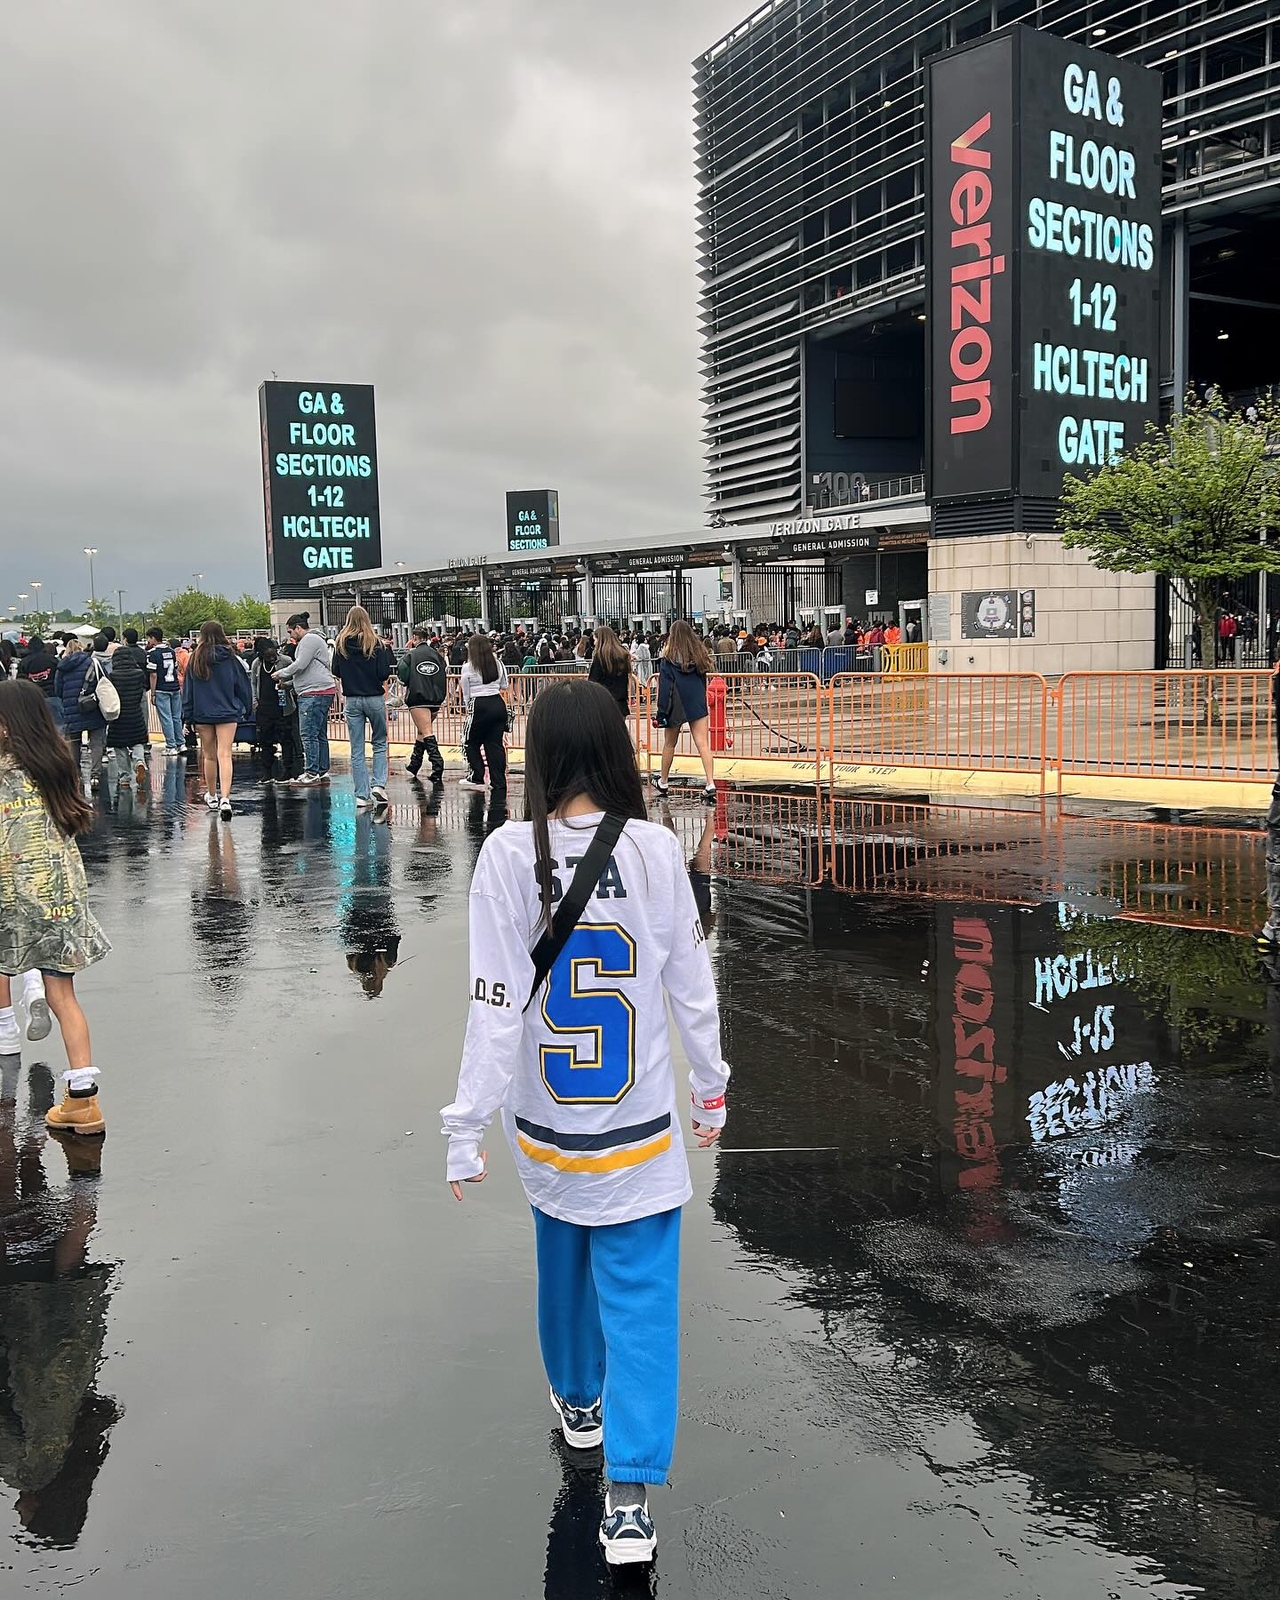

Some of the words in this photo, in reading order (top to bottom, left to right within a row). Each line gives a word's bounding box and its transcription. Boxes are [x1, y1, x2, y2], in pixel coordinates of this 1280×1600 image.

[1063, 63, 1102, 121] GA
[1106, 77, 1124, 127] &
[1049, 130, 1137, 199] FLOOR
[1028, 197, 1154, 271] SECTIONS
[950, 112, 1005, 435] verizon
[1069, 278, 1118, 332] 1-12
[1033, 342, 1148, 403] HCLTECH
[298, 391, 328, 414] GA
[330, 392, 345, 415] &
[289, 422, 356, 446] FLOOR
[1058, 416, 1125, 467] GATE
[275, 453, 372, 477] SECTIONS
[307, 484, 344, 508] 1-12
[282, 515, 370, 539] HCLTECH
[518, 510, 530, 521] GA
[530, 510, 537, 521] &
[768, 518, 821, 537] VERIZON
[825, 514, 859, 532] GATE
[515, 524, 542, 536] FLOOR
[509, 538, 548, 550] SECTIONS
[792, 541, 826, 552] GENERAL
[828, 537, 870, 550] ADMISSION
[302, 546, 354, 569] GATE
[628, 557, 652, 566] GENERAL
[653, 554, 684, 565] ADMISSION
[511, 567, 529, 576] GENERAL
[163, 659, 175, 682] 7
[834, 765, 861, 774] YOUR
[868, 766, 897, 776] STEP
